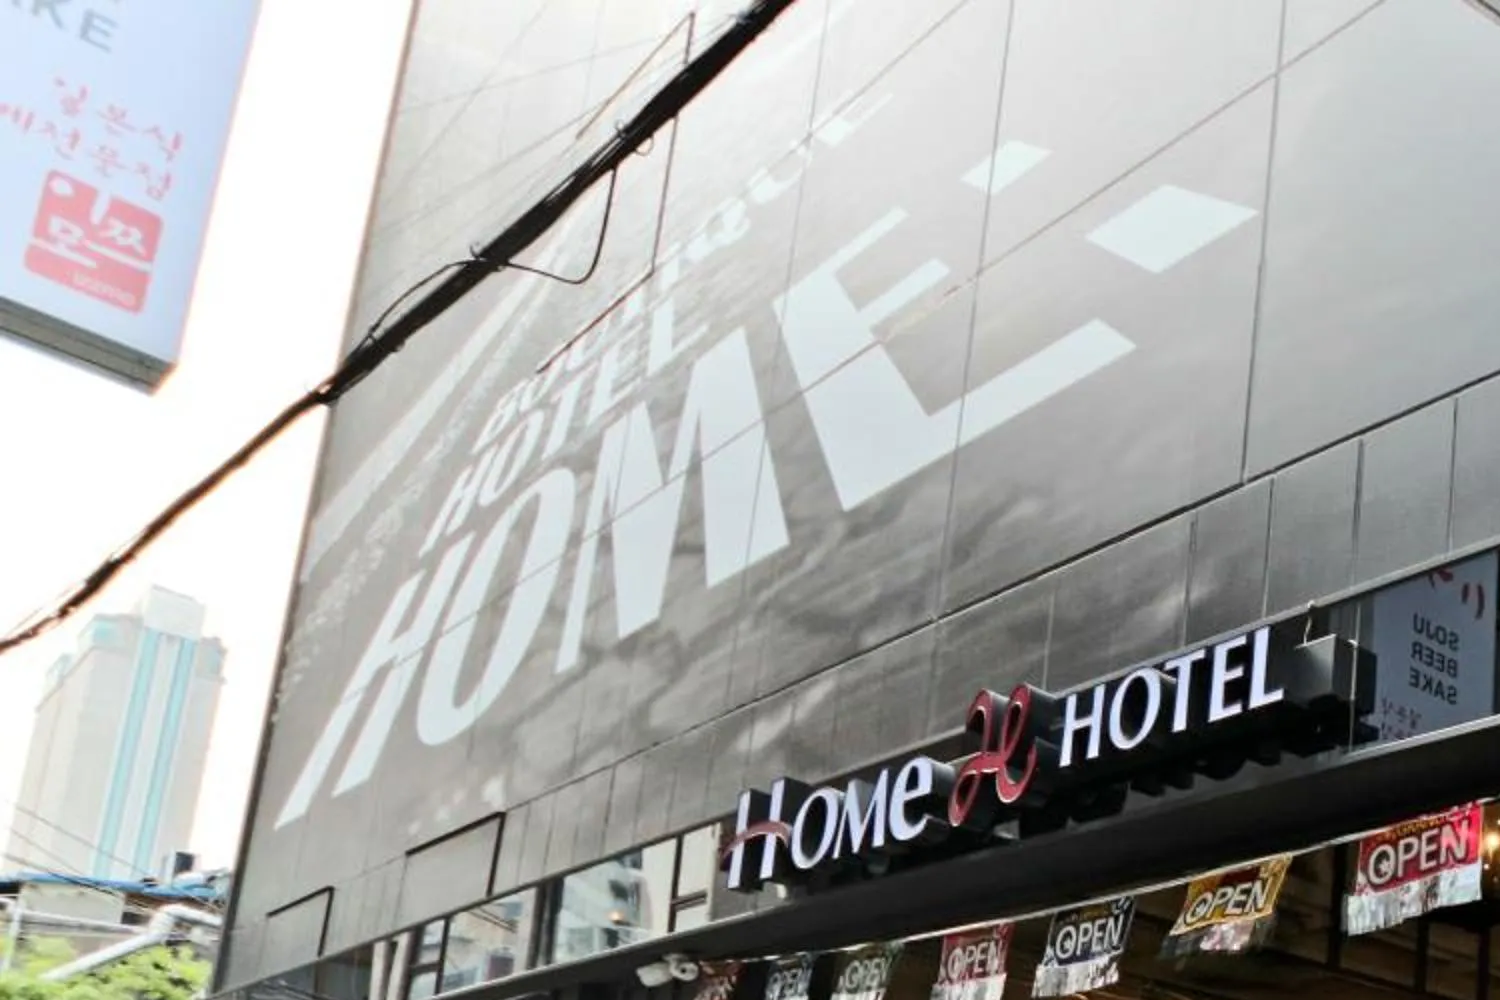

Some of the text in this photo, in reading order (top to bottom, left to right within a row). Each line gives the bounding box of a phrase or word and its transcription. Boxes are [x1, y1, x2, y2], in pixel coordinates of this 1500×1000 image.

[1059, 625, 1284, 768] HOTEL
[1367, 819, 1469, 886] OPEN
[1185, 878, 1268, 923] OPEN
[949, 938, 1002, 981] OPEN
[1055, 915, 1124, 959] OPEN
